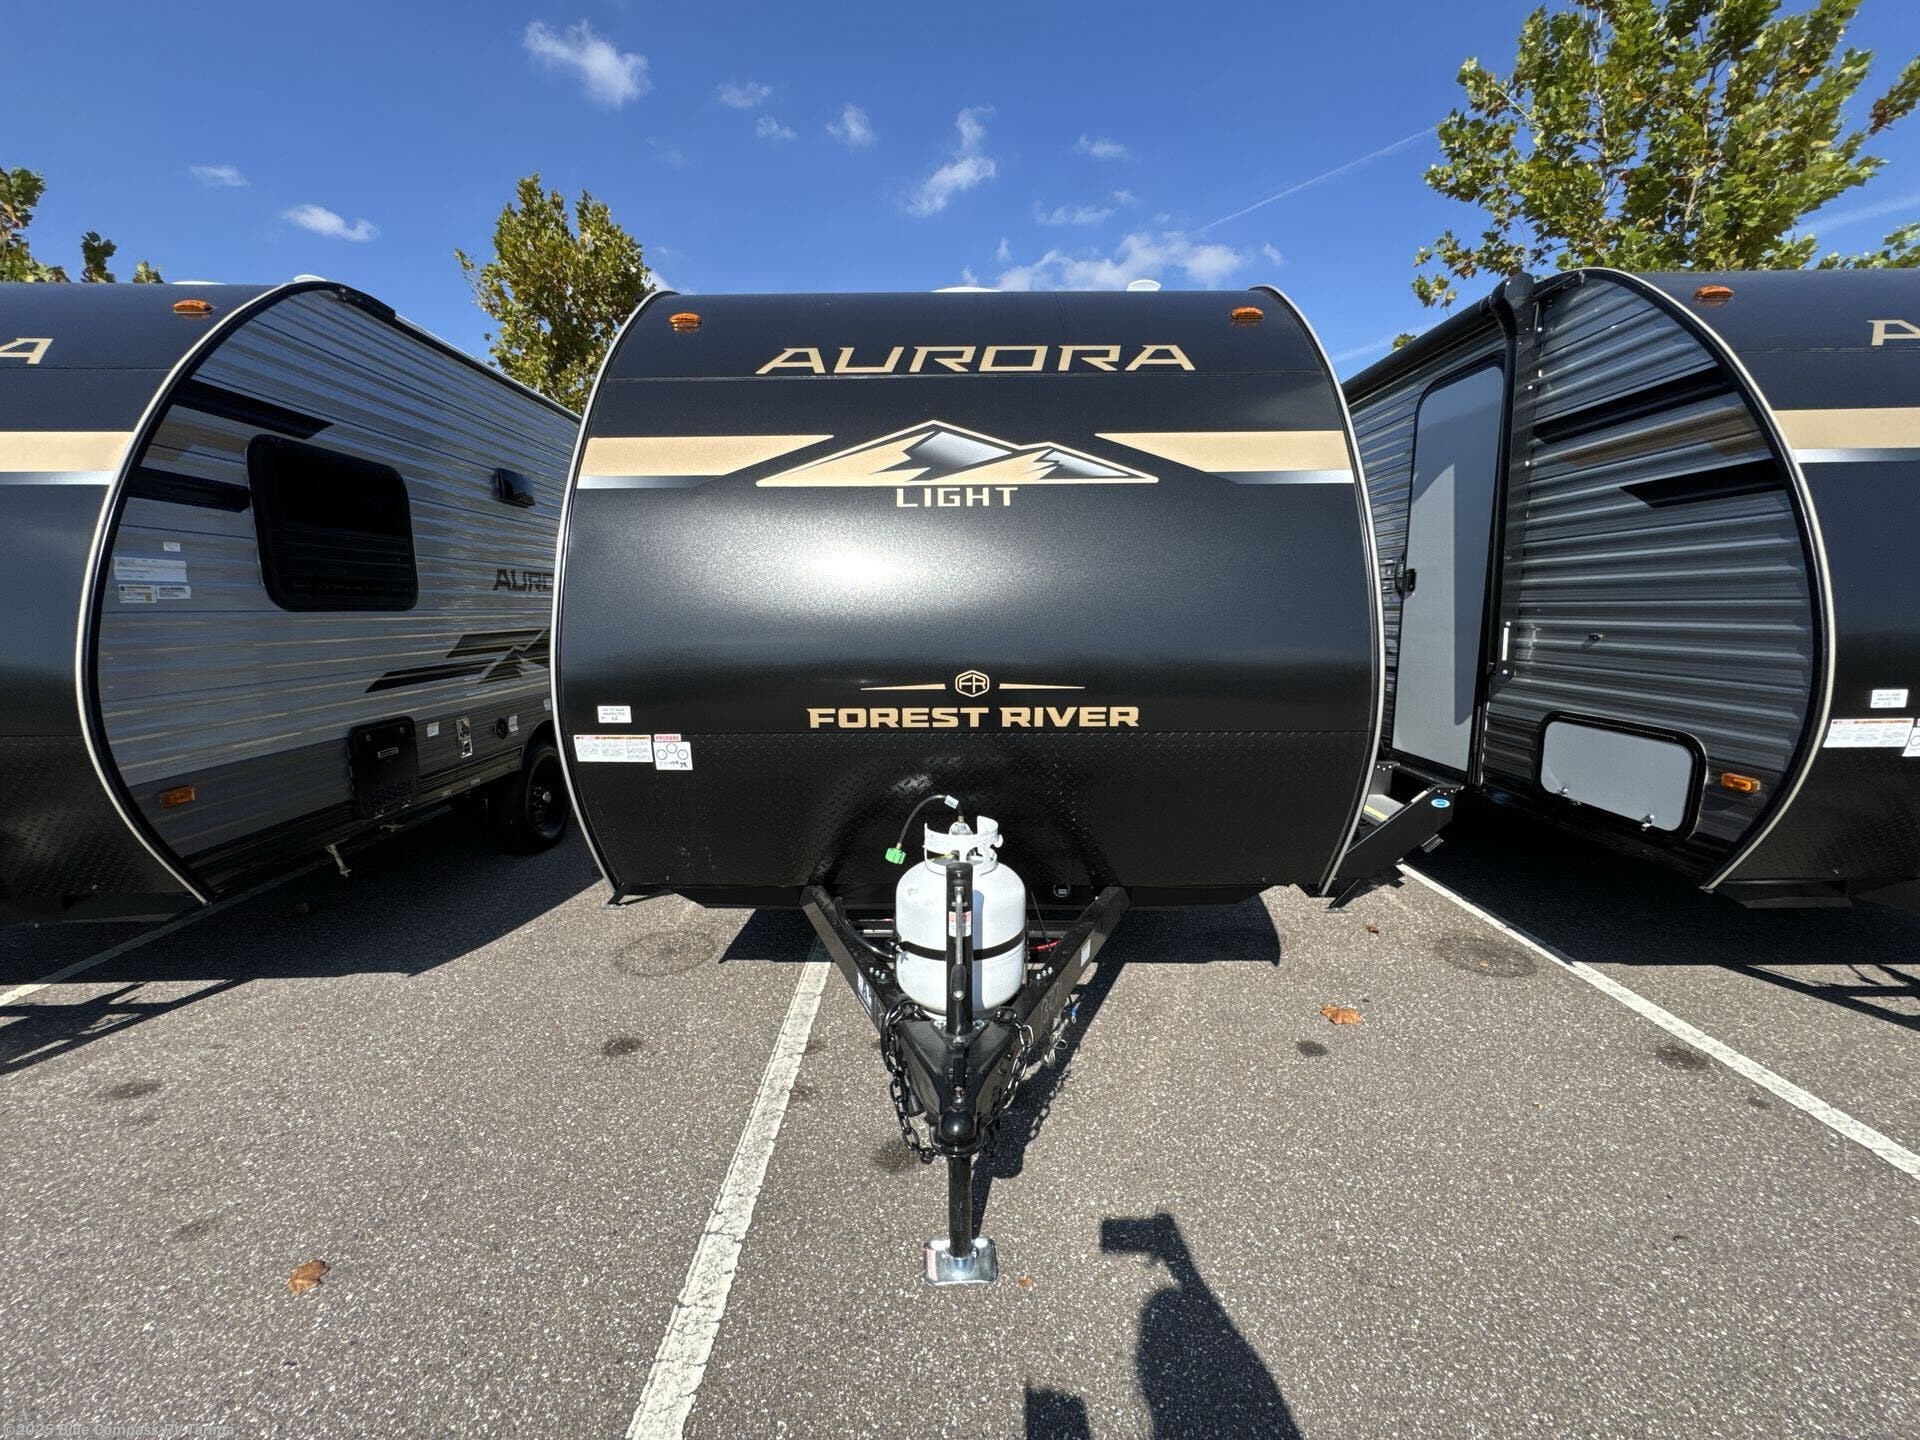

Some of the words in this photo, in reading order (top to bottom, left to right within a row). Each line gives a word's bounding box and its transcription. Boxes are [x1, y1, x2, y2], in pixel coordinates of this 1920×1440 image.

[755, 344, 1196, 375] AURORA
[896, 487, 1018, 507] LIGHT
[807, 707, 989, 729] FOREST
[999, 706, 1139, 728] RIVER
